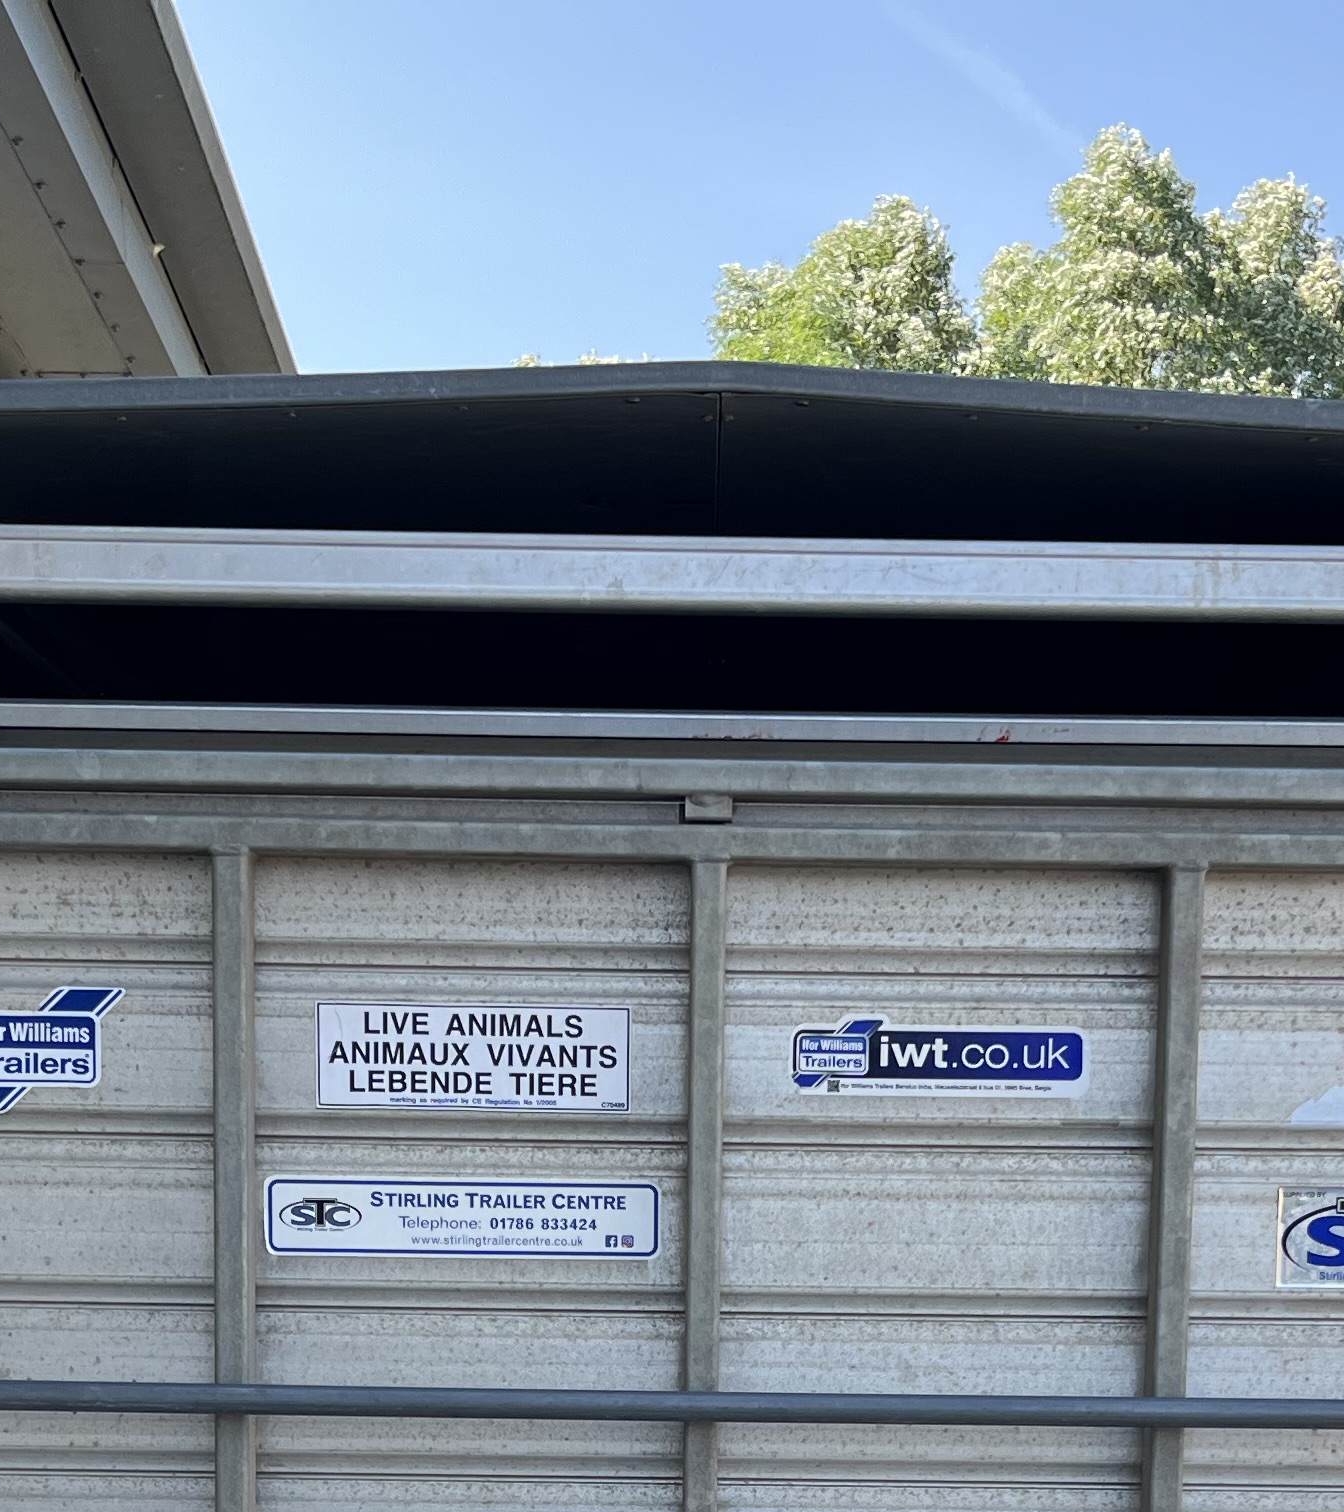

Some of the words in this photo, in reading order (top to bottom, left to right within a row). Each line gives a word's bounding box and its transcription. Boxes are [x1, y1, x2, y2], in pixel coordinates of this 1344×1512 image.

[9, 1021, 90, 1043] Williams
[363, 1011, 429, 1035] LIVE
[445, 1013, 583, 1038] ANIMALS
[329, 1040, 470, 1066] ANIMAUX
[487, 1043, 617, 1069] VIVANTS
[802, 1039, 818, 1051] Ifor
[820, 1039, 864, 1052] Williams
[879, 1036, 1070, 1069] iwt.co.uk
[802, 1055, 863, 1069] Trailers
[349, 1069, 492, 1095] LEBENDE
[509, 1073, 598, 1097] TIERE
[370, 1191, 459, 1208] STIRLING
[465, 1193, 546, 1210] TRAILER
[552, 1194, 627, 1210] CENTRE
[290, 1198, 351, 1227] STC
[398, 1215, 482, 1232] Telephone:
[490, 1217, 534, 1230] 01786
[541, 1218, 598, 1231] 833424
[411, 1234, 584, 1248] www.stirlingtrailercentre.co.uk
